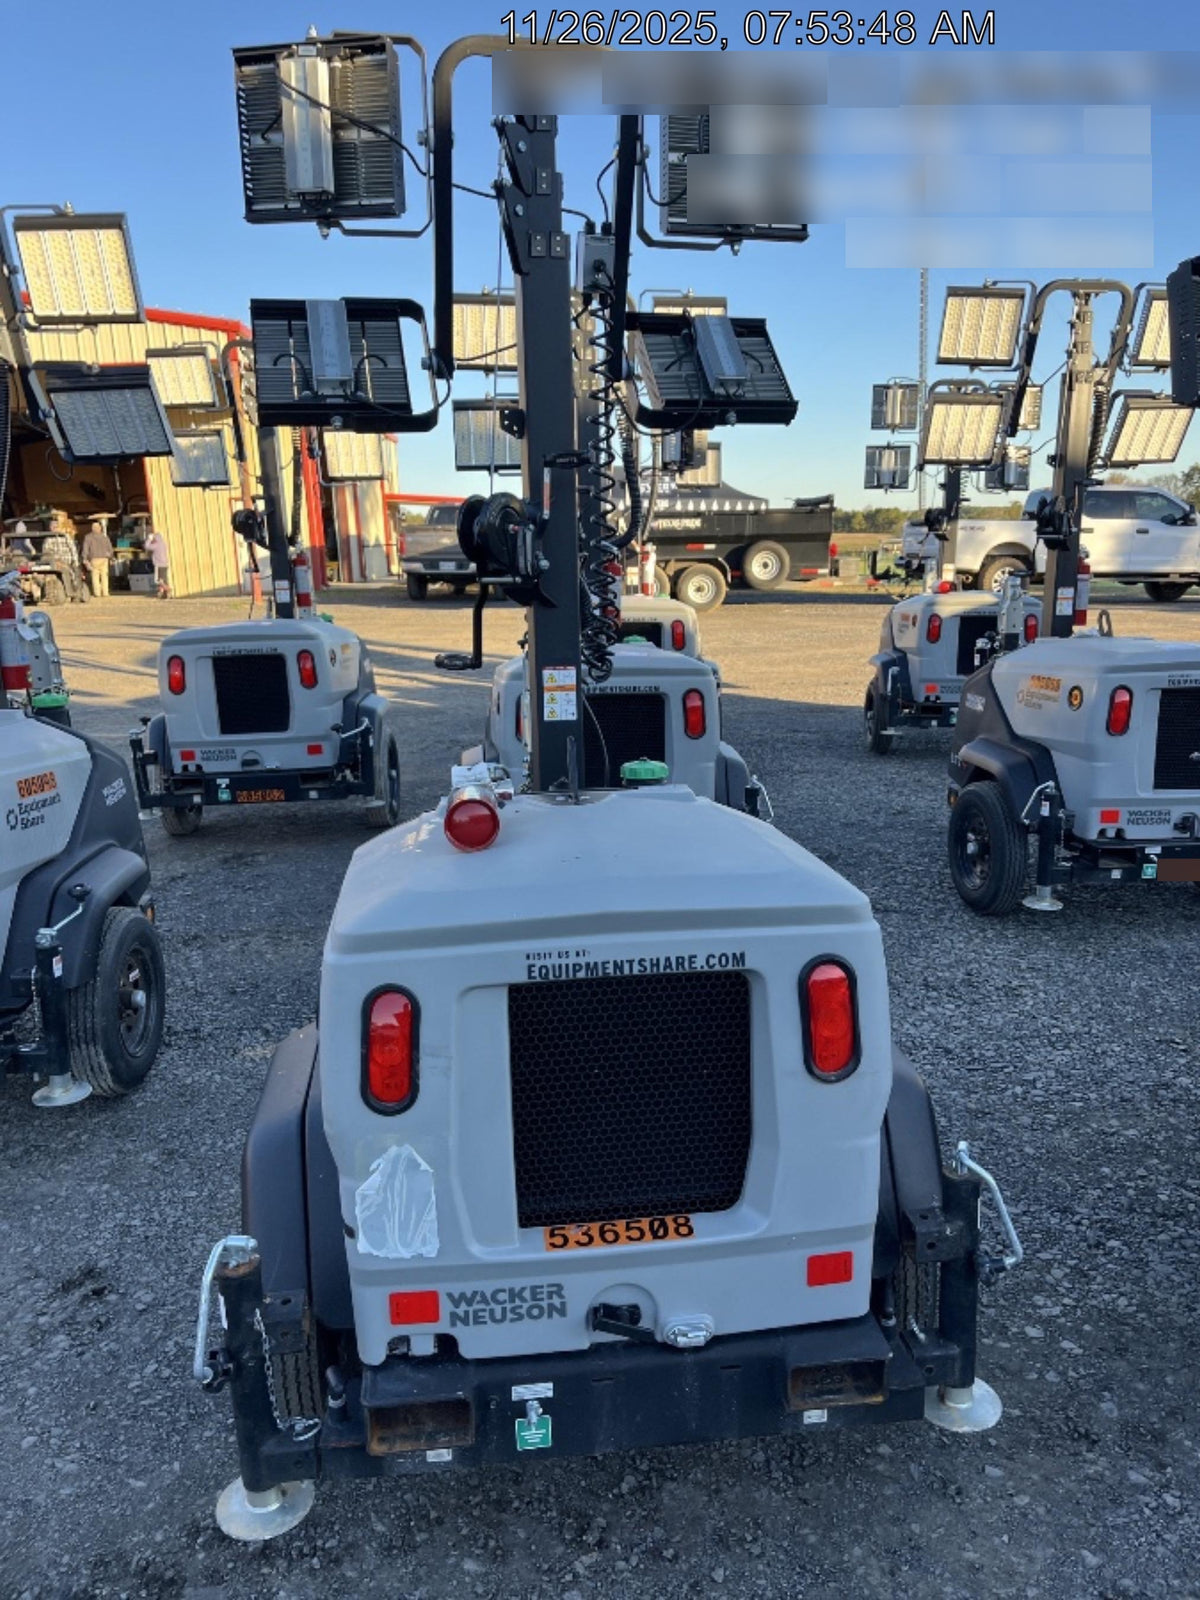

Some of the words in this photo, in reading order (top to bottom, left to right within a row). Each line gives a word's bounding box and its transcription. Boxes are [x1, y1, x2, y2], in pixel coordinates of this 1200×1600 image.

[1127, 817, 1171, 826] NEUSON
[527, 951, 746, 981] EQUIPMENTSHARE.COM
[548, 1214, 694, 1250] 536508
[445, 1283, 566, 1309] WACKER
[449, 1301, 567, 1328] NEUSON
